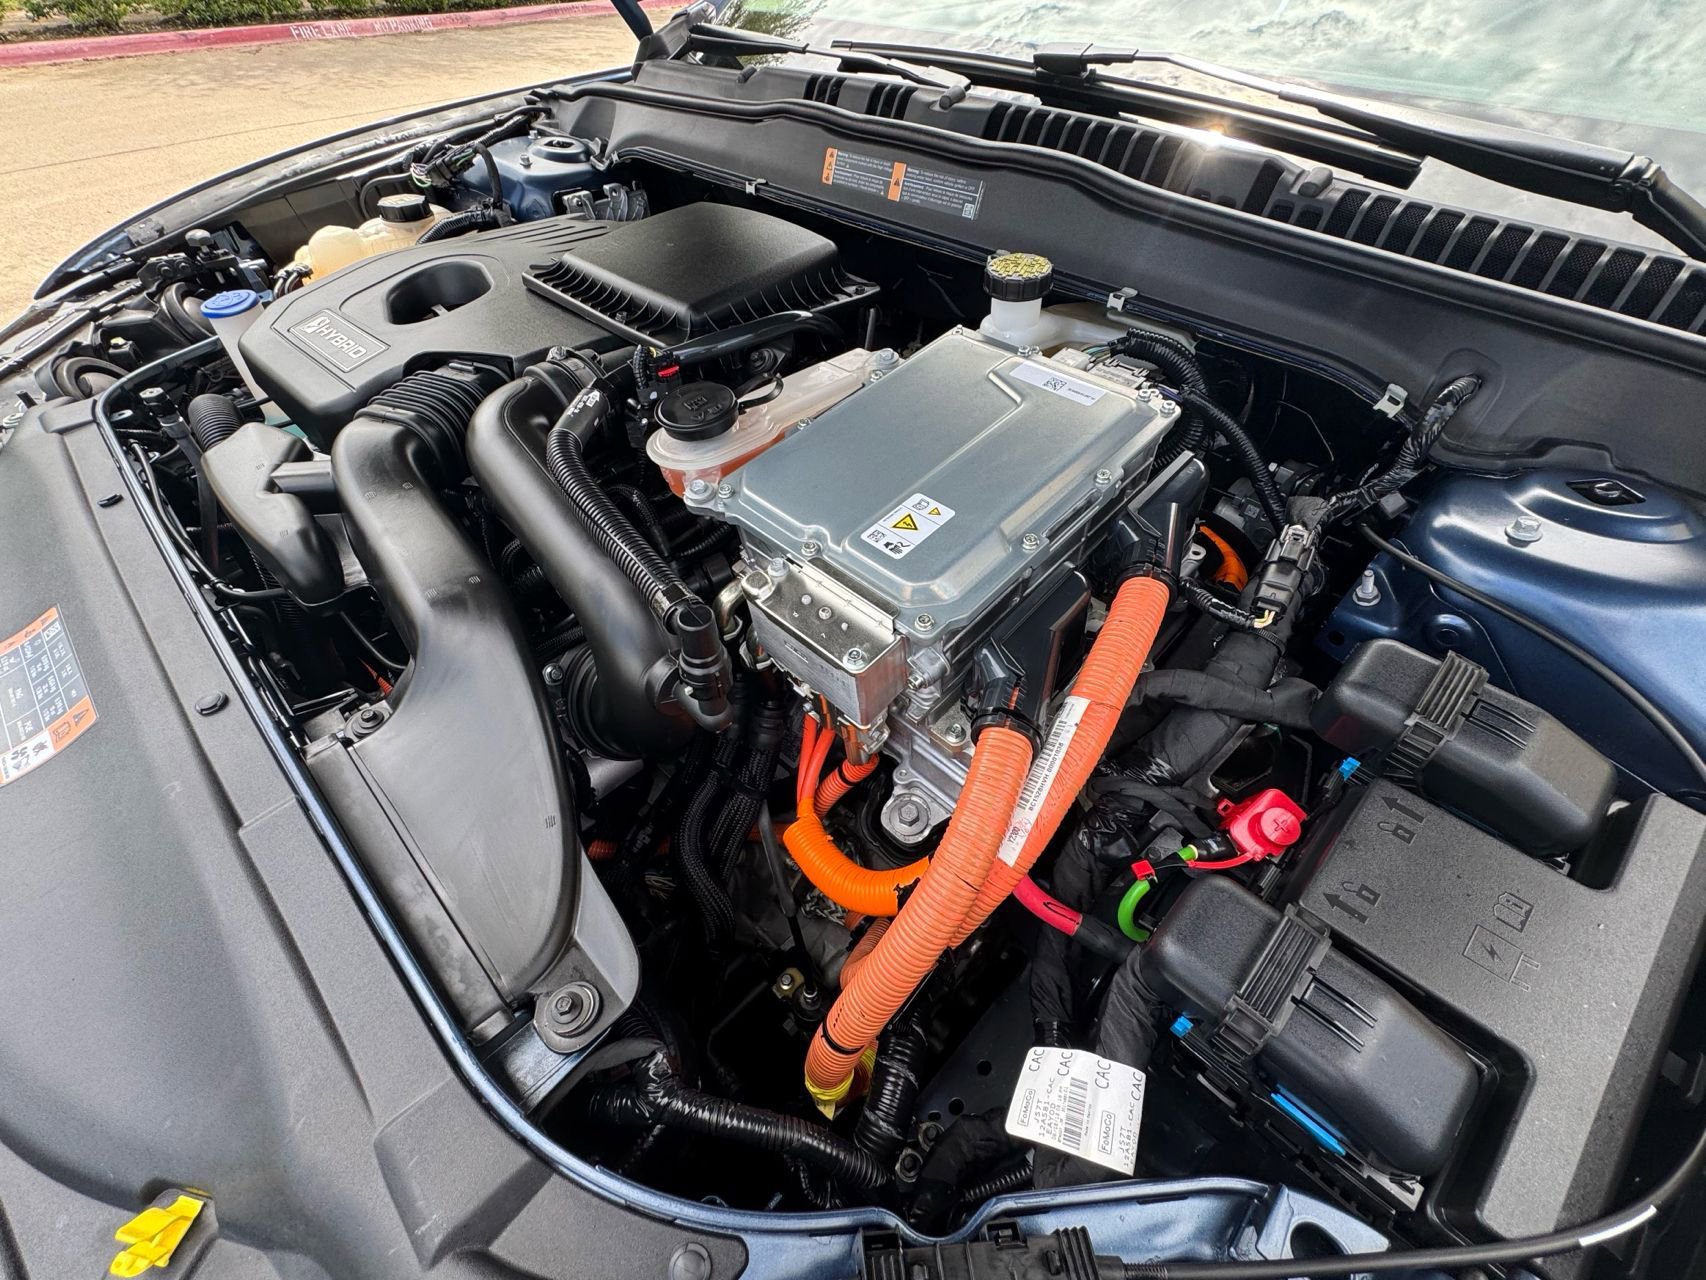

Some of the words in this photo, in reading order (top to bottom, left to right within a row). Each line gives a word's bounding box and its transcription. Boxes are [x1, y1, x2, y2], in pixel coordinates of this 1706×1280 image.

[290, 25, 320, 40] FIRE
[374, 20, 388, 33] NO
[389, 16, 434, 32] PARKING
[315, 324, 367, 359] HYBRID
[1029, 1049, 1045, 1072] CAC
[1057, 1051, 1073, 1077] CAC
[1094, 1060, 1112, 1089] CAC
[1130, 1071, 1143, 1101] CAC
[1020, 1090, 1033, 1124] FoMoCo
[1101, 1113, 1113, 1154] FoMoCo
